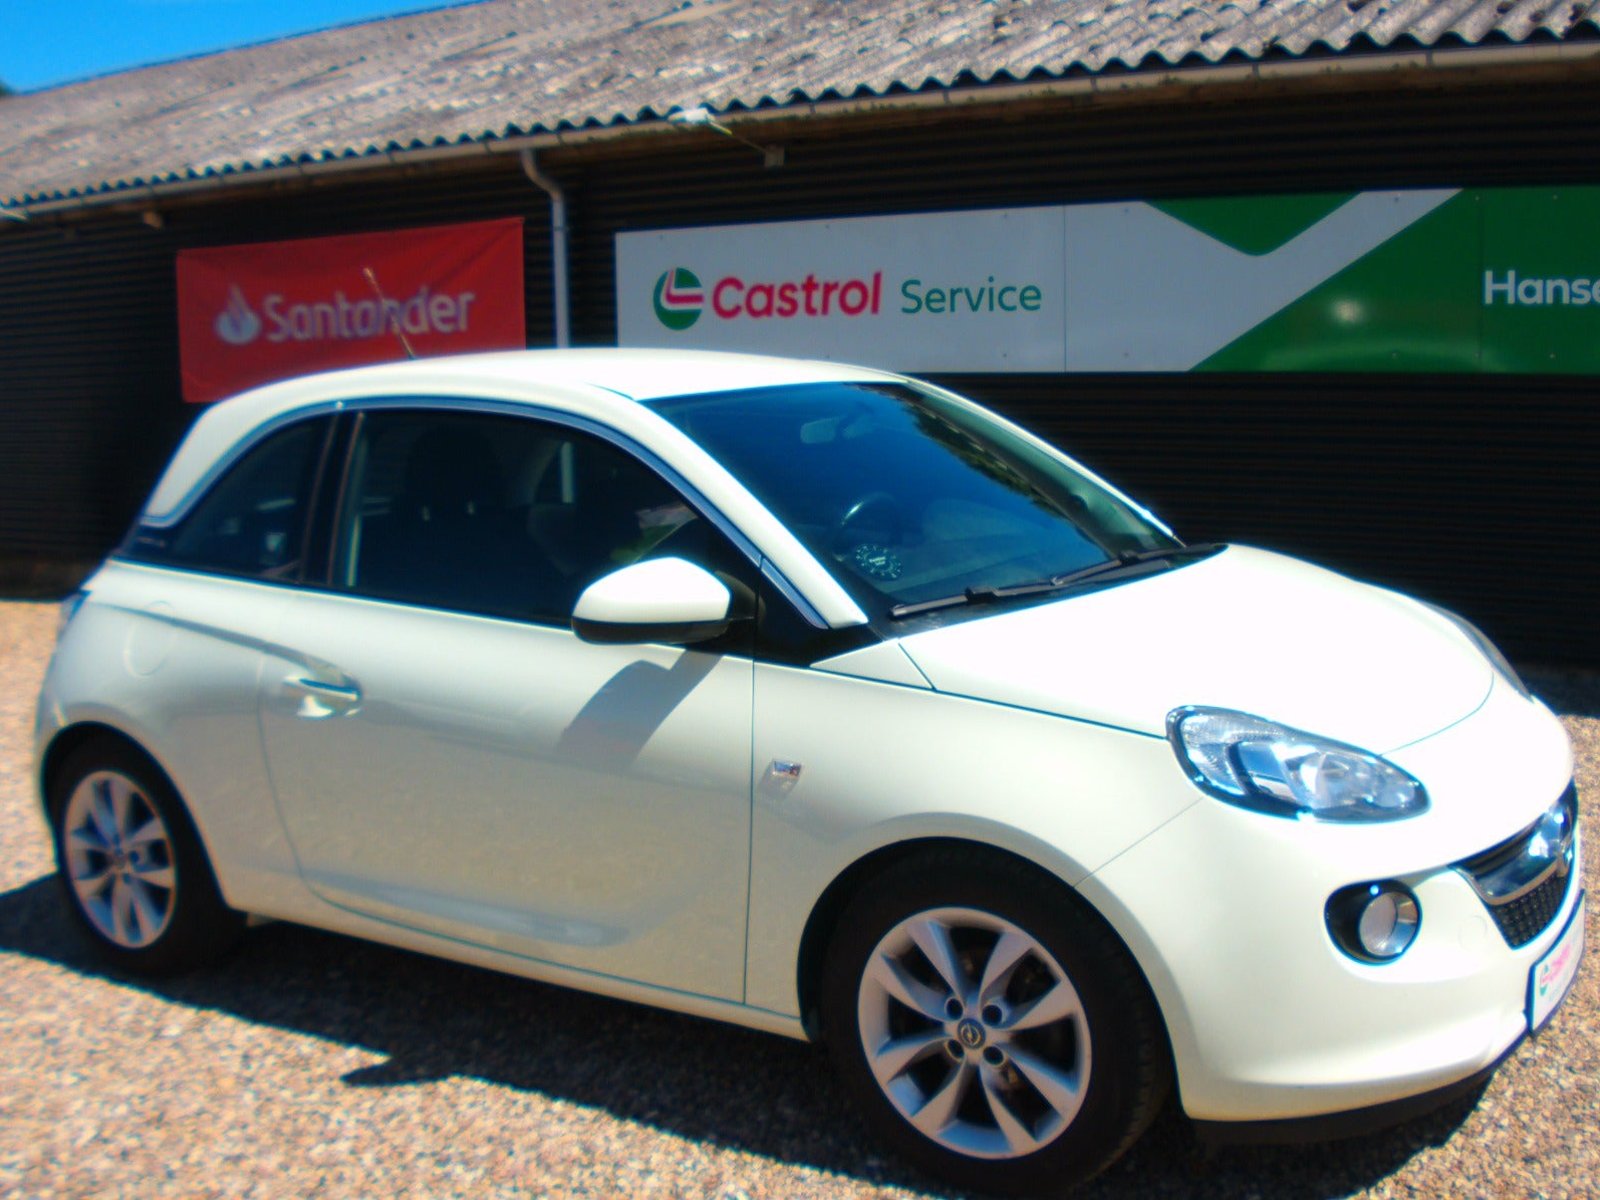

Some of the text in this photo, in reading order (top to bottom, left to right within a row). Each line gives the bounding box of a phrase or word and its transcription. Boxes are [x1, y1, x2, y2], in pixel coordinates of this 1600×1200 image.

[263, 285, 474, 342] Santander
[713, 271, 1042, 319] Castrol Service
